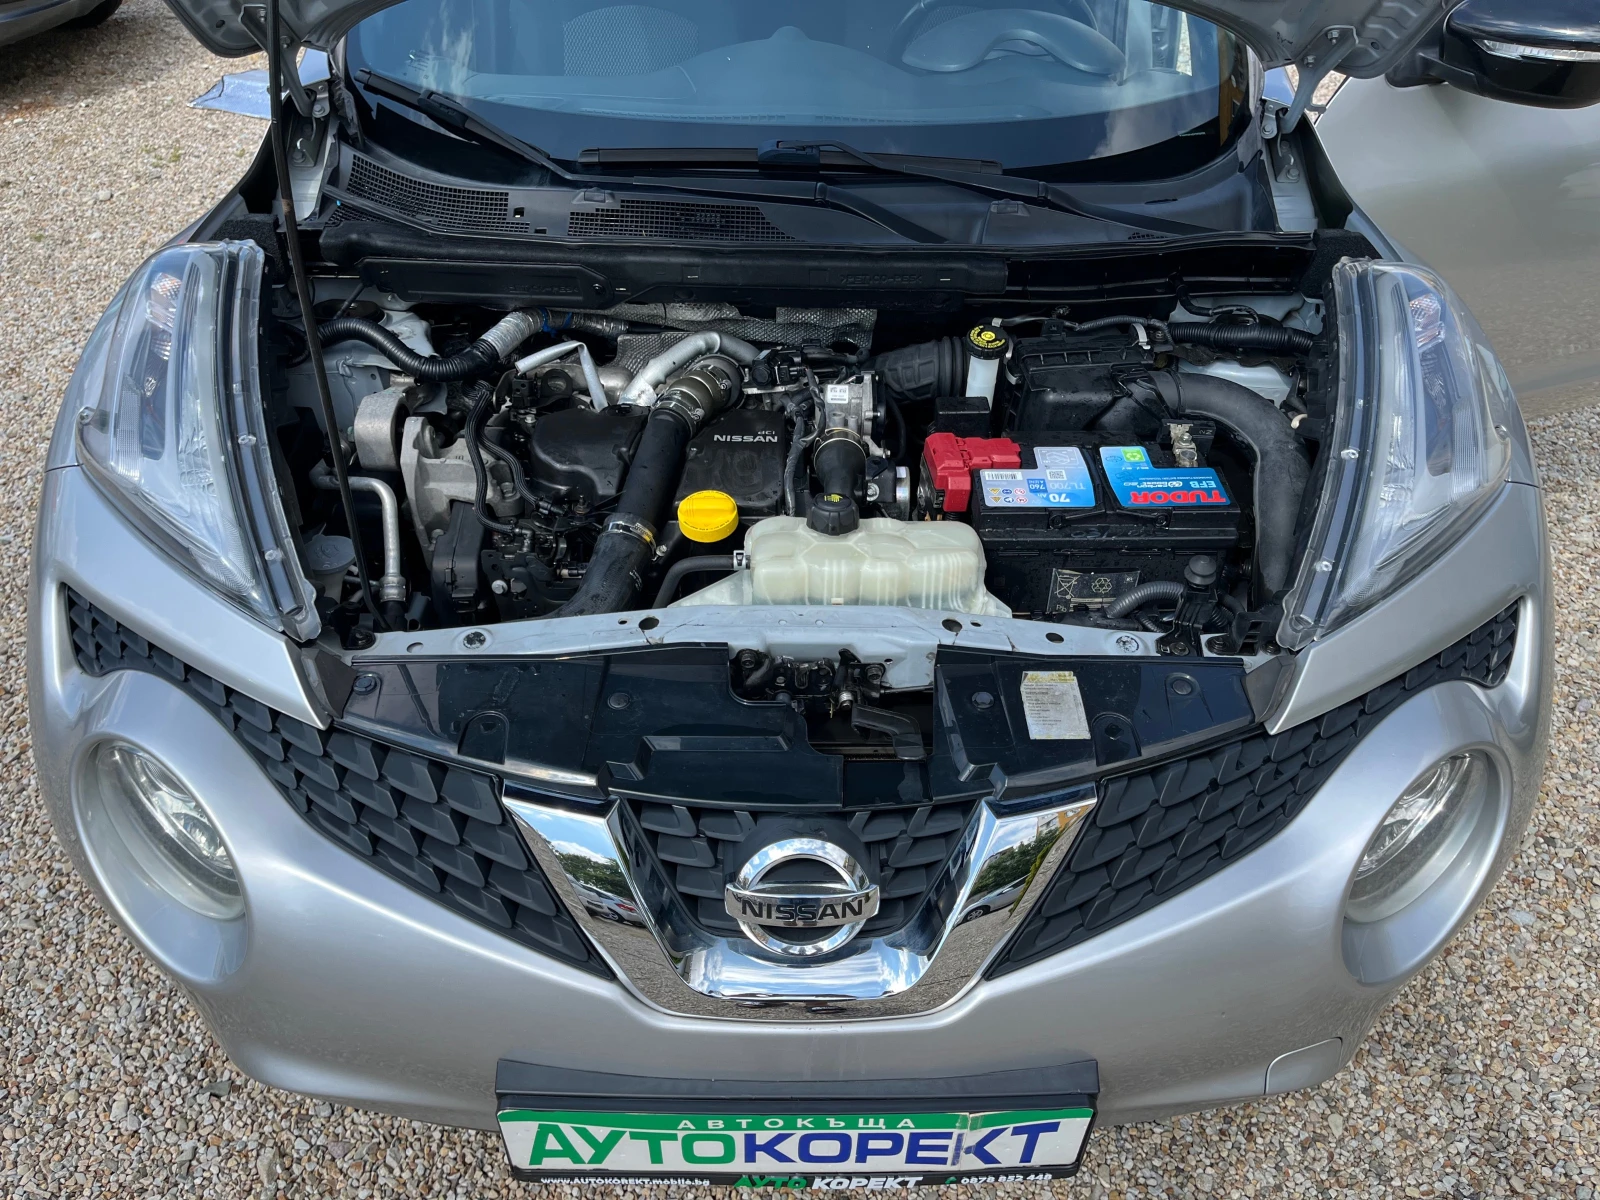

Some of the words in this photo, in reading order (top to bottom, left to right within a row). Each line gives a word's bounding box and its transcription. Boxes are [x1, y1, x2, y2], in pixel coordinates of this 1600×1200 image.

[713, 434, 778, 443] NISSAN
[1049, 482, 1088, 490] TL700
[1189, 480, 1217, 488] EFB
[1048, 493, 1071, 503] 70
[1130, 490, 1226, 504] TUDOR
[741, 898, 864, 921] NISSAN
[677, 1117, 916, 1130] АВТОКЪЩА
[529, 1121, 1061, 1167] АУТОКОРЕКТ
[541, 1176, 710, 1187] www.AUTOKOREKT.mobile.bg
[734, 1175, 808, 1189] АУТО
[812, 1175, 924, 1190] КОРЕКТ
[961, 1175, 996, 1185] 0878
